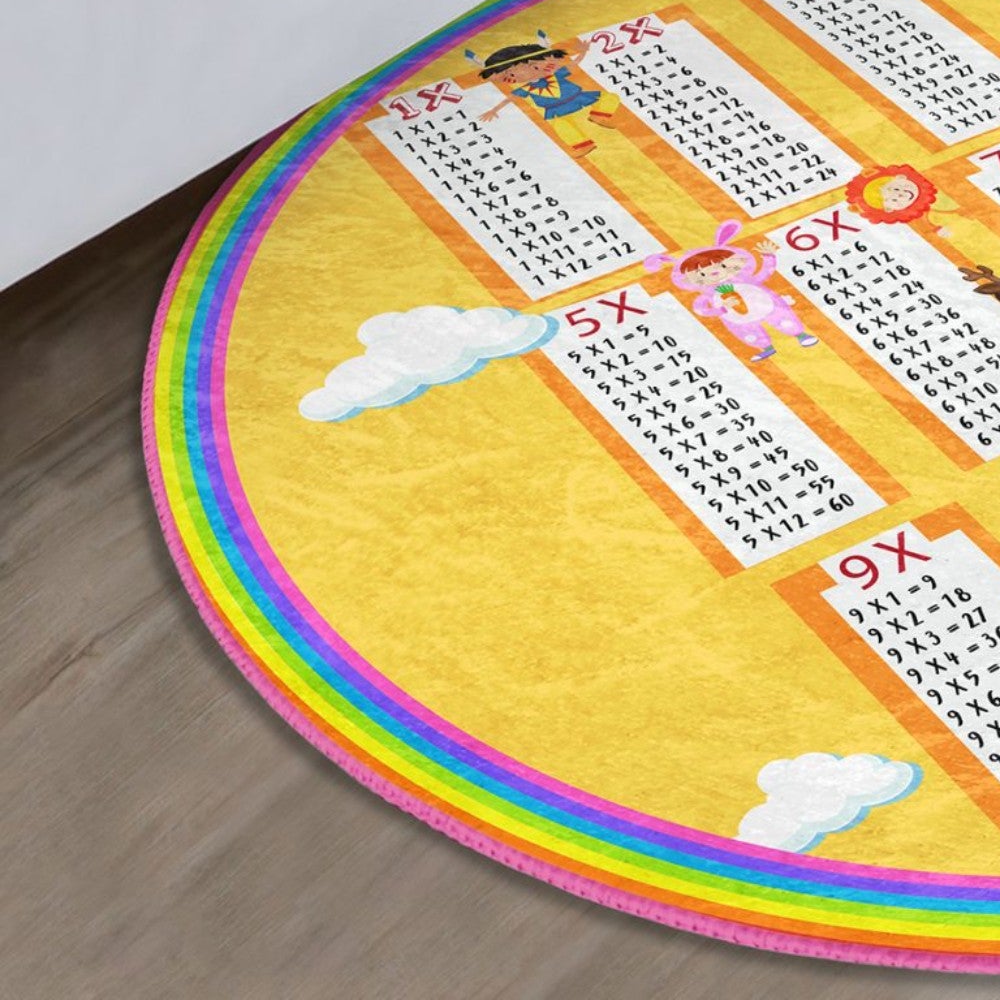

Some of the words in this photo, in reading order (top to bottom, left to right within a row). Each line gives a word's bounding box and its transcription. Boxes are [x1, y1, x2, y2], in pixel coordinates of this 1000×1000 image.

[855, 53, 868, 64] 3
[883, 43, 896, 54] 6
[909, 31, 933, 44] 18
[687, 145, 702, 157] 2
[717, 134, 732, 145] 8
[746, 120, 771, 135] 16
[943, 122, 957, 134] 3
[971, 108, 997, 123] 12
[440, 180, 453, 191] 1
[471, 168, 485, 180] 5
[503, 157, 517, 169] 5
[744, 195, 760, 208] 2
[774, 181, 801, 196] 12
[815, 167, 837, 182] 24
[532, 274, 545, 286] 1
[565, 257, 593, 274] 12
[609, 241, 636, 257] 12
[806, 278, 821, 291] 6
[836, 266, 854, 280] 2
[867, 250, 895, 267] 12
[611, 397, 626, 411] 5
[647, 385, 661, 397] 4
[682, 365, 709, 384] 20
[940, 399, 956, 414] 6
[971, 381, 998, 399] 10
[741, 533, 757, 550] 5
[778, 513, 810, 533] 12
[828, 492, 855, 512] 60
[886, 647, 903, 664] 9
[924, 630, 941, 646] 3
[961, 605, 987, 629] 27
